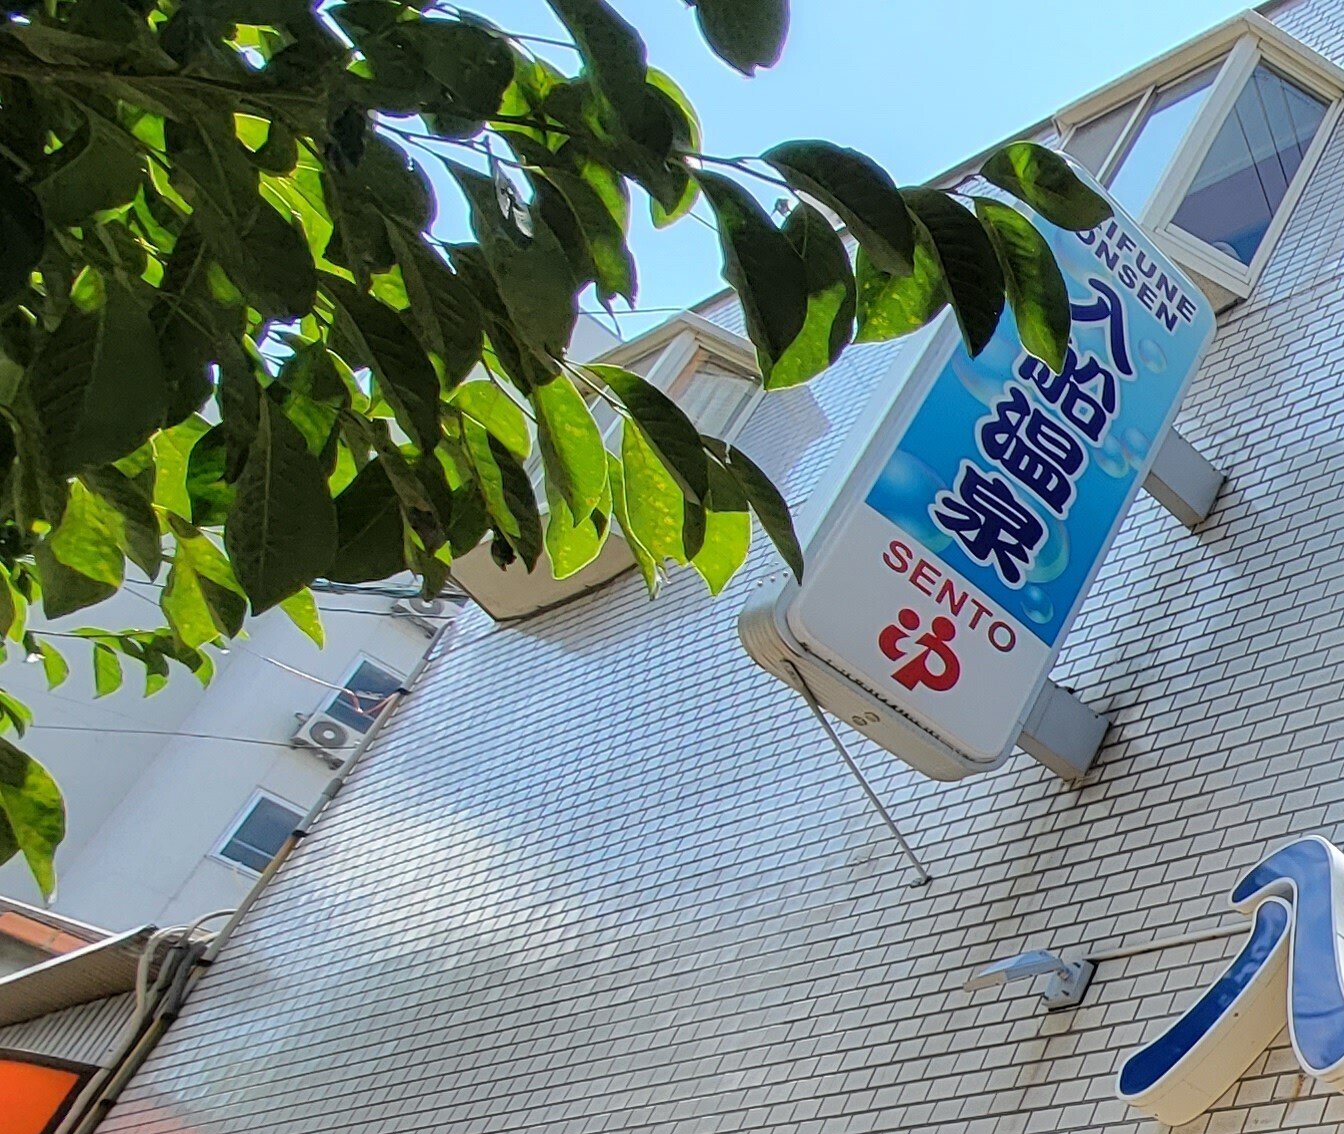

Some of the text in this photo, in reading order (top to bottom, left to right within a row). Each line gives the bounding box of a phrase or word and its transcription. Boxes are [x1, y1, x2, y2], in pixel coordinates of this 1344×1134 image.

[1098, 220, 1197, 323] IFUNE
[936, 278, 1134, 585] 入船温泉
[882, 539, 1017, 653] SENTO
